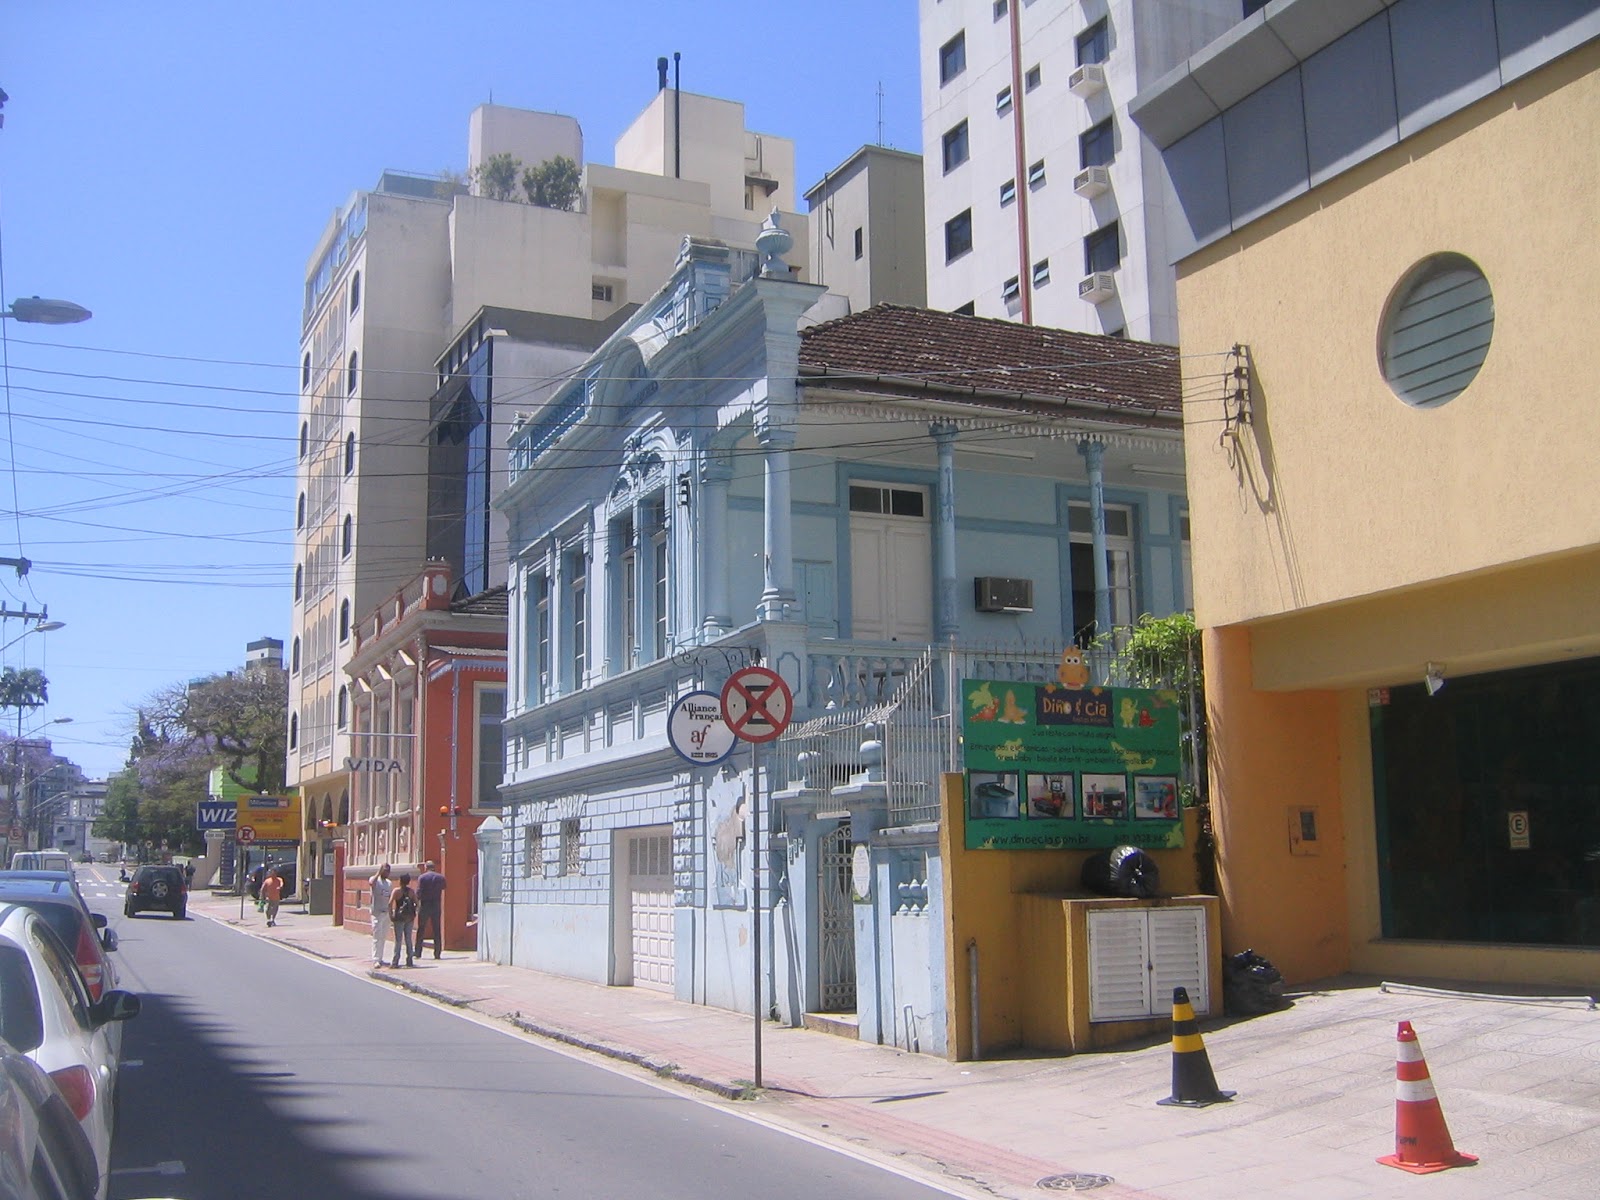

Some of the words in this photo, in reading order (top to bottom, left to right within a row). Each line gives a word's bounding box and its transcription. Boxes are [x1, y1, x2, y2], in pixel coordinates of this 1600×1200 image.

[680, 703, 717, 713] Alliance
[689, 711, 724, 722] Françai
[348, 759, 403, 772] VIDA
[1515, 819, 1522, 830] E
